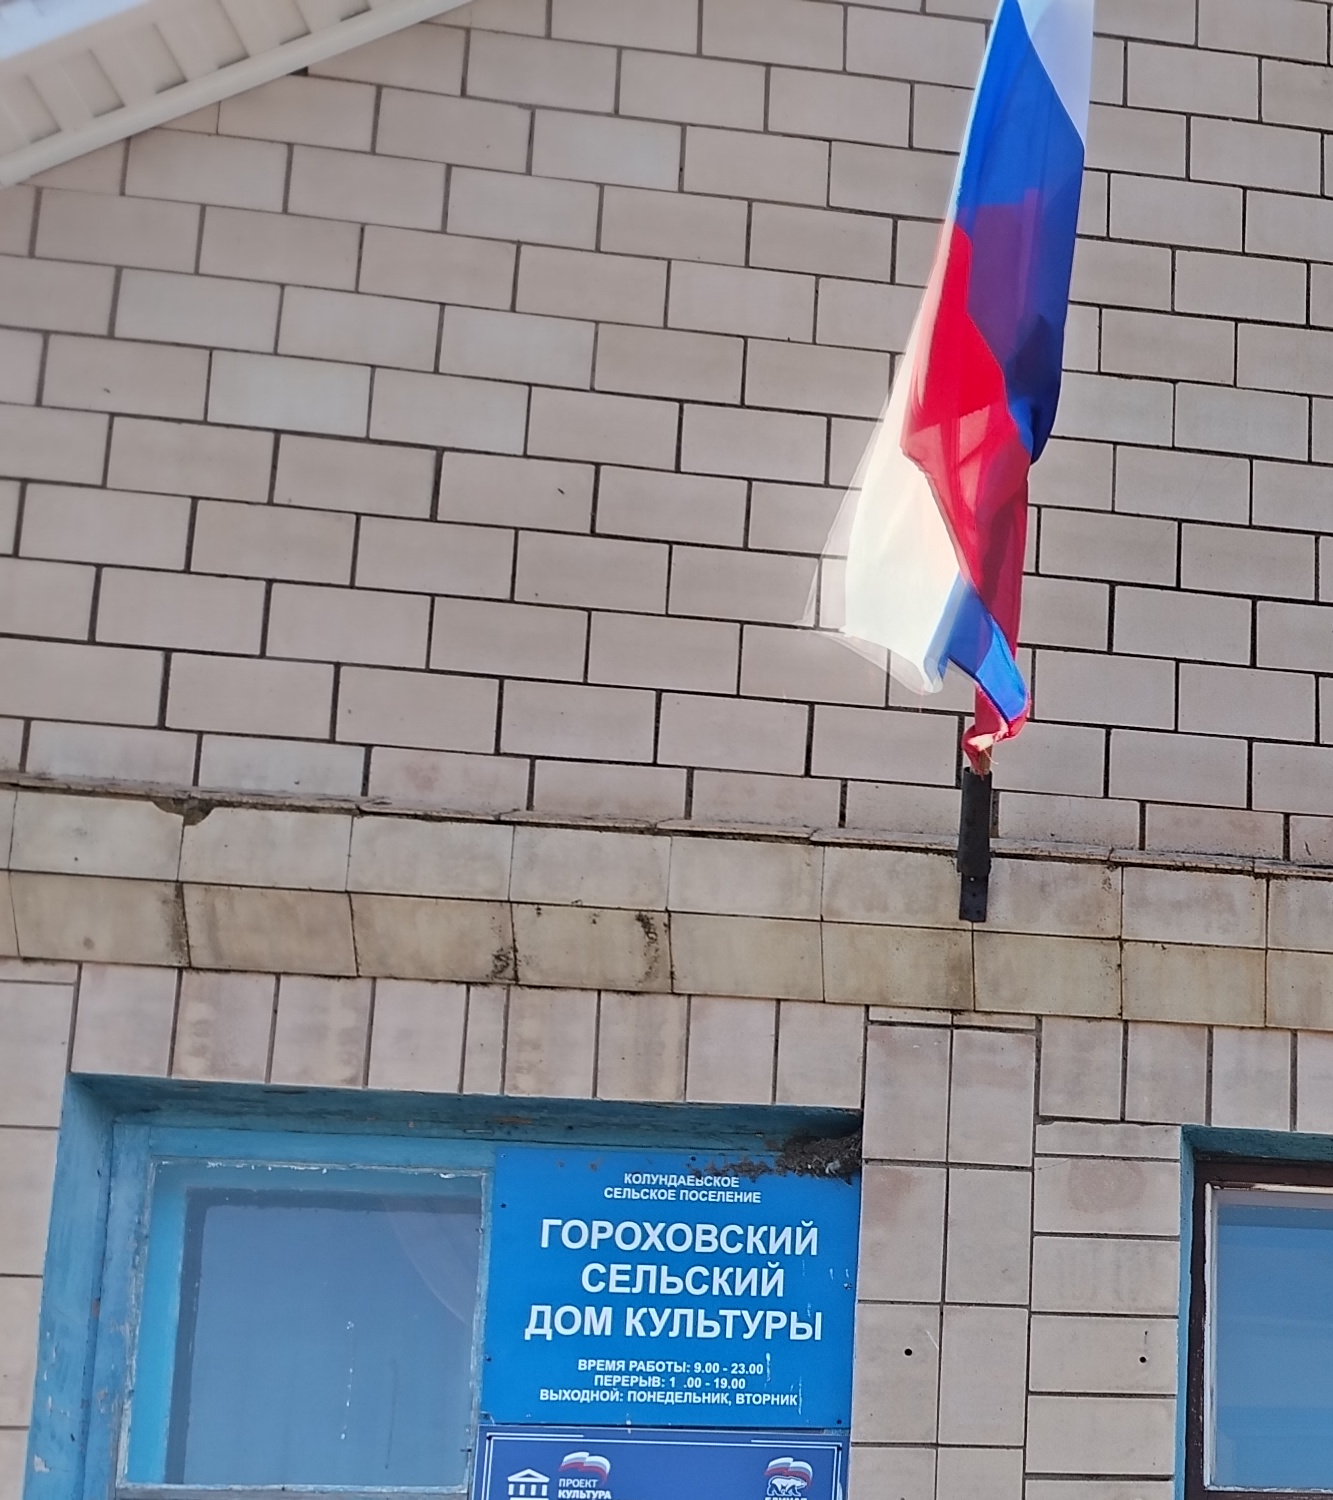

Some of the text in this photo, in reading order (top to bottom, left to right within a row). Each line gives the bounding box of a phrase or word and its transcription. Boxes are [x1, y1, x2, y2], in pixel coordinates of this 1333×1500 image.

[624, 1172, 740, 1188] КОЛУНДАЕВСКОЕ
[603, 1187, 761, 1203] СЕЛЬСКОЕ ПОСЕЛЕНИЕ
[540, 1218, 819, 1256] ГОРОХОВСКИЙ
[581, 1260, 785, 1298] СЕЛЬСКИЙ
[524, 1304, 823, 1341] ДОМ КУЛЬТУРЫ
[578, 1359, 626, 1372] ВРЕМЯ
[629, 1360, 691, 1373] РАБОТЫ:
[693, 1362, 720, 1374] 9.00
[730, 1363, 764, 1375] 23.00
[594, 1374, 666, 1388] ПЕРЕРЫВ:
[713, 1377, 746, 1389] 19.00
[539, 1387, 798, 1407] ВЫХОДНОЙ: ПОНЕДЕЛЬНИК, ВТОРНИК
[558, 1478, 598, 1489] ПРОЕКТ
[557, 1489, 612, 1500] КУЛЬТУРА
